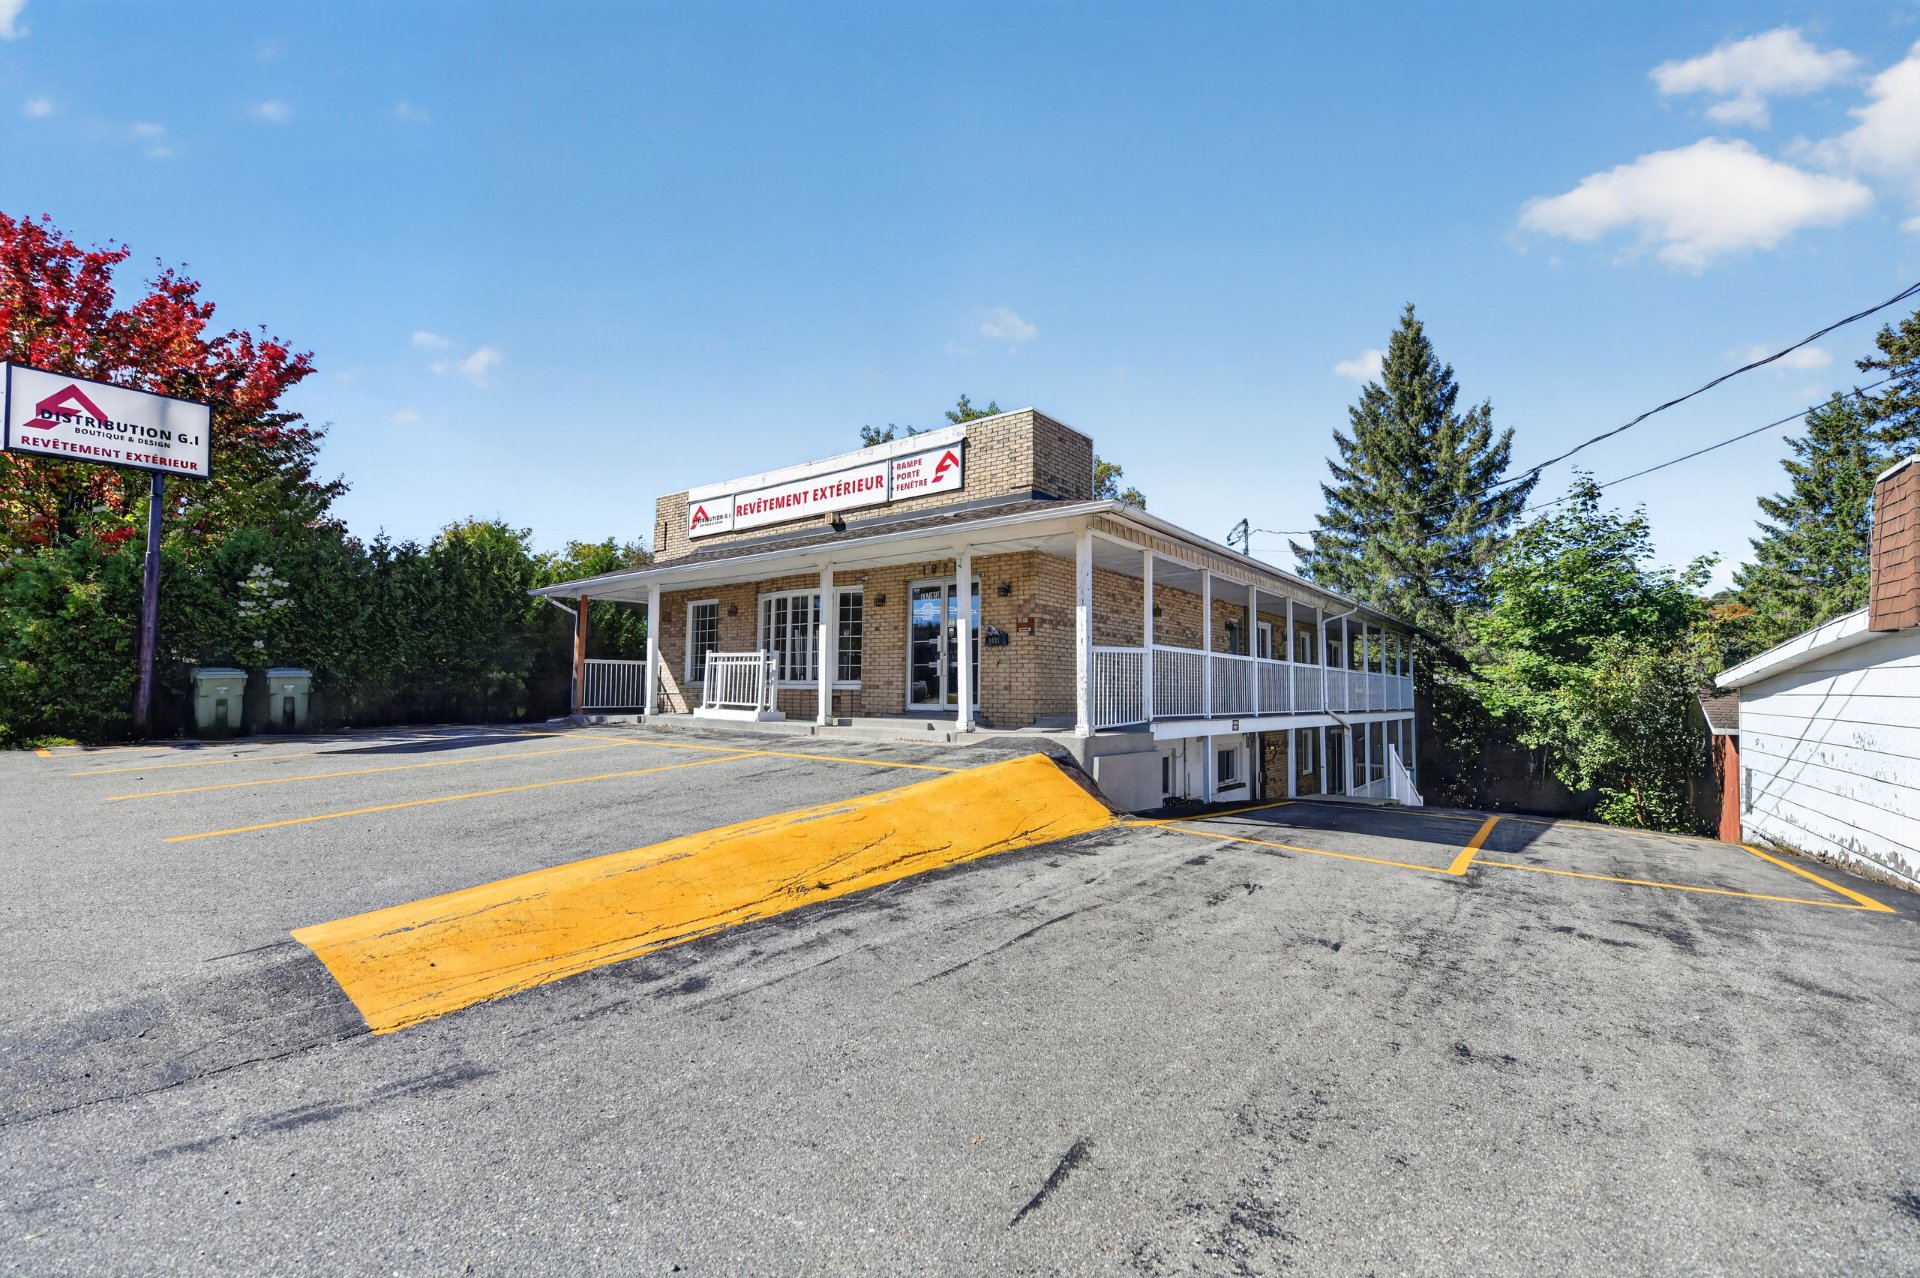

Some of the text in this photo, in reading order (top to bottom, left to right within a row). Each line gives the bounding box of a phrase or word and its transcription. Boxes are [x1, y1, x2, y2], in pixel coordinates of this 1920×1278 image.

[41, 408, 199, 446] DISTRIBUTION G.I
[74, 427, 125, 442] BOUTIQUE
[138, 437, 171, 449] DESIGN
[21, 435, 198, 471] REVÊTEMENT EXTÉRIEUR
[896, 458, 922, 470] RAMPE
[896, 469, 920, 481] PORTE
[896, 478, 928, 491] FENÊTRE
[736, 474, 884, 517] REVÊTEMENT EXTÉRIEUR
